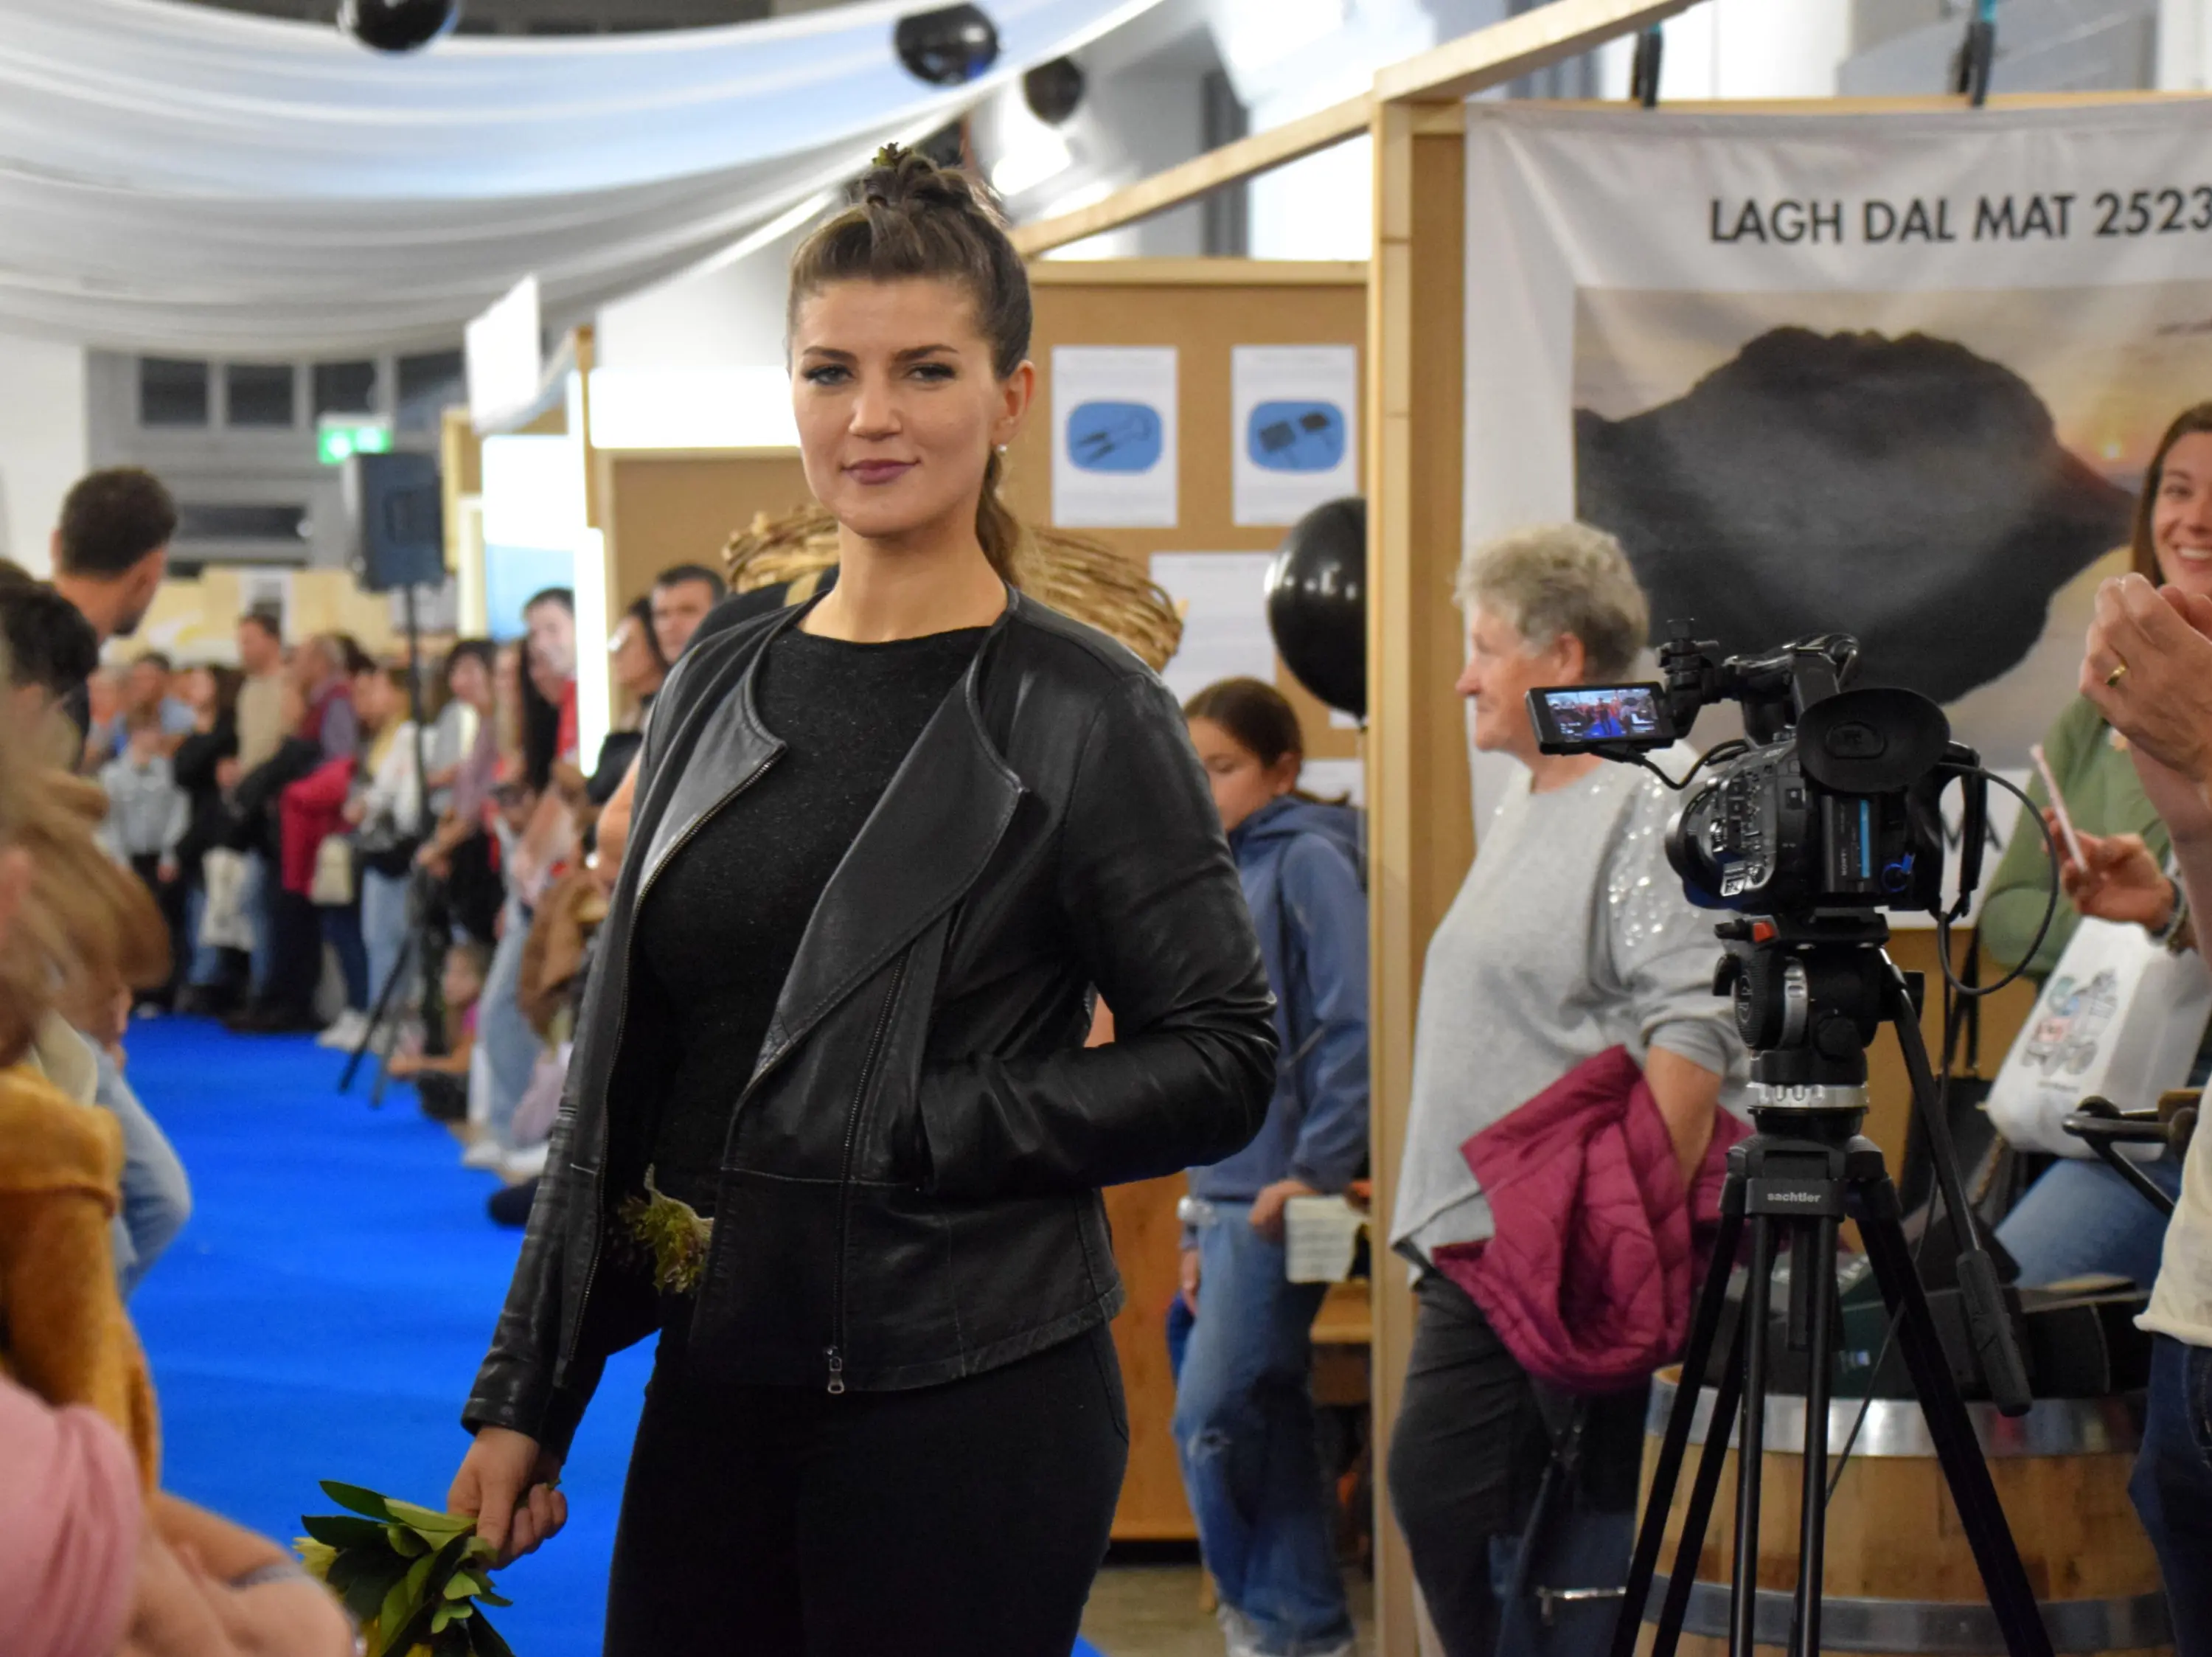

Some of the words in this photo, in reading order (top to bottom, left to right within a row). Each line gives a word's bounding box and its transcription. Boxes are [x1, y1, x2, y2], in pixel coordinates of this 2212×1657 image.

[1710, 197, 1843, 243] LAGH
[1863, 196, 1955, 243] DAL
[1972, 192, 2076, 241] MAT
[2093, 184, 2212, 237] 2523
